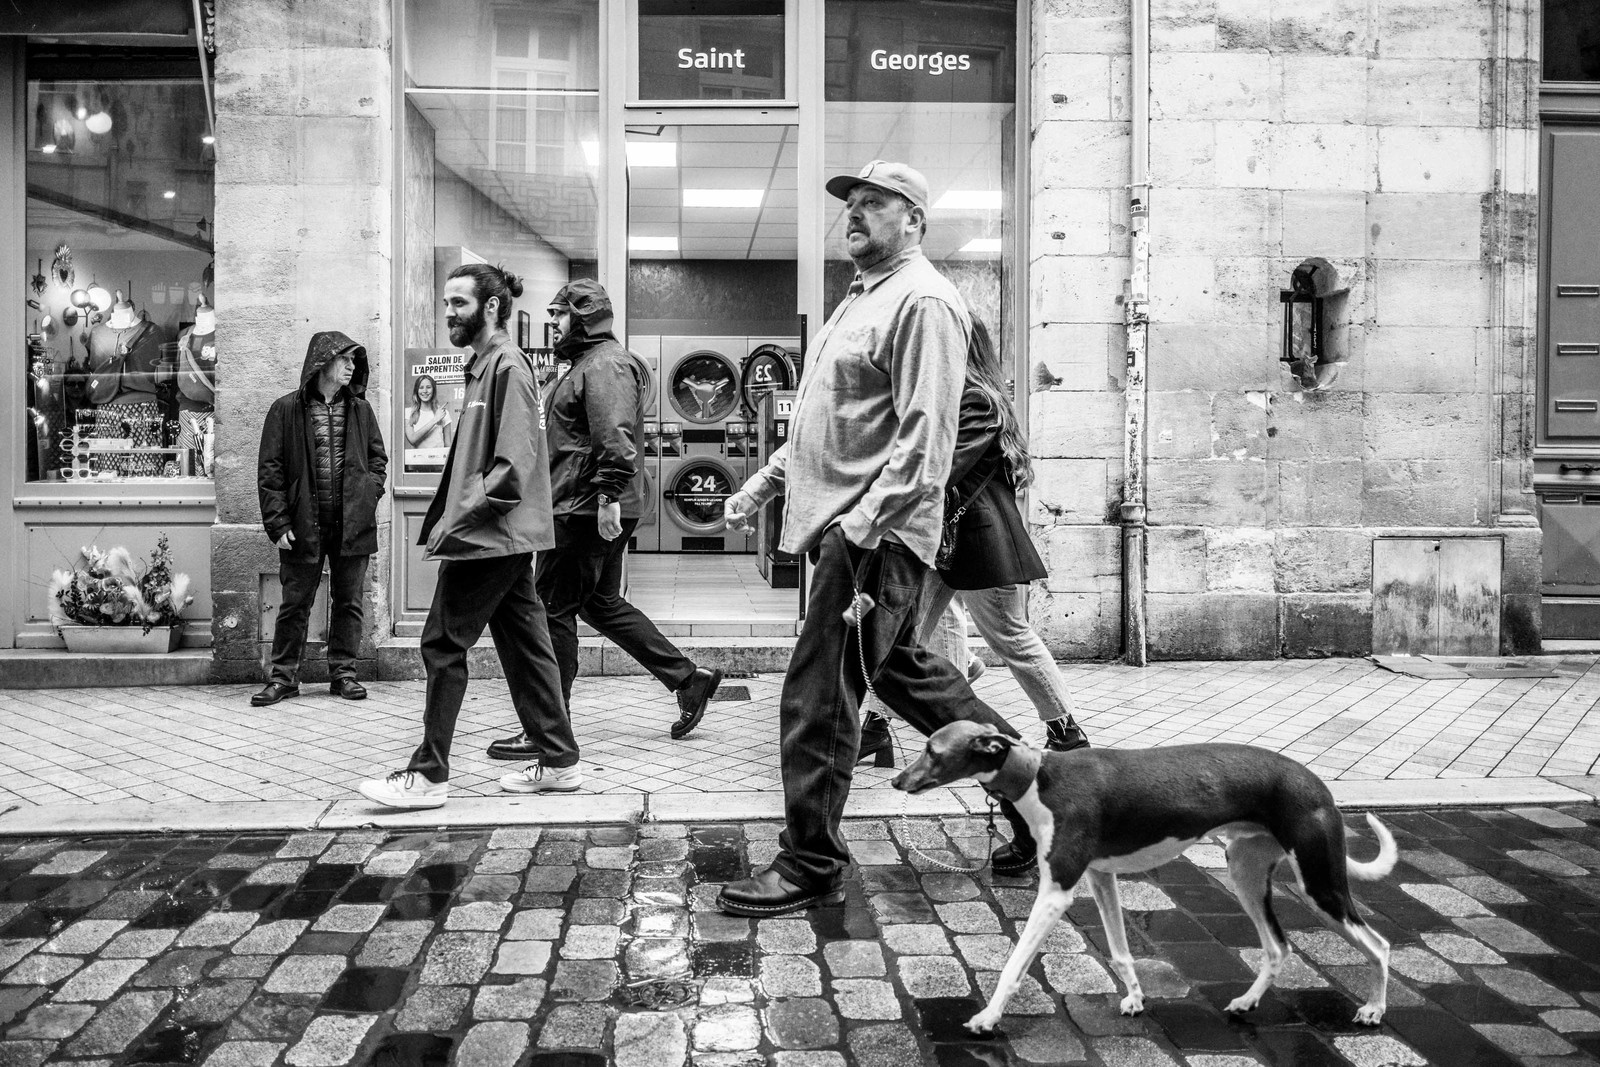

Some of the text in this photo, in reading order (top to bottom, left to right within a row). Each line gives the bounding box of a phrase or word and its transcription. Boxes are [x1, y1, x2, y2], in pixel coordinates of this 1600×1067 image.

[677, 47, 971, 75] Saint Georges
[428, 355, 463, 365] SALON DE
[453, 387, 465, 399] 16
[779, 403, 791, 412] 11
[691, 475, 716, 492] 24
